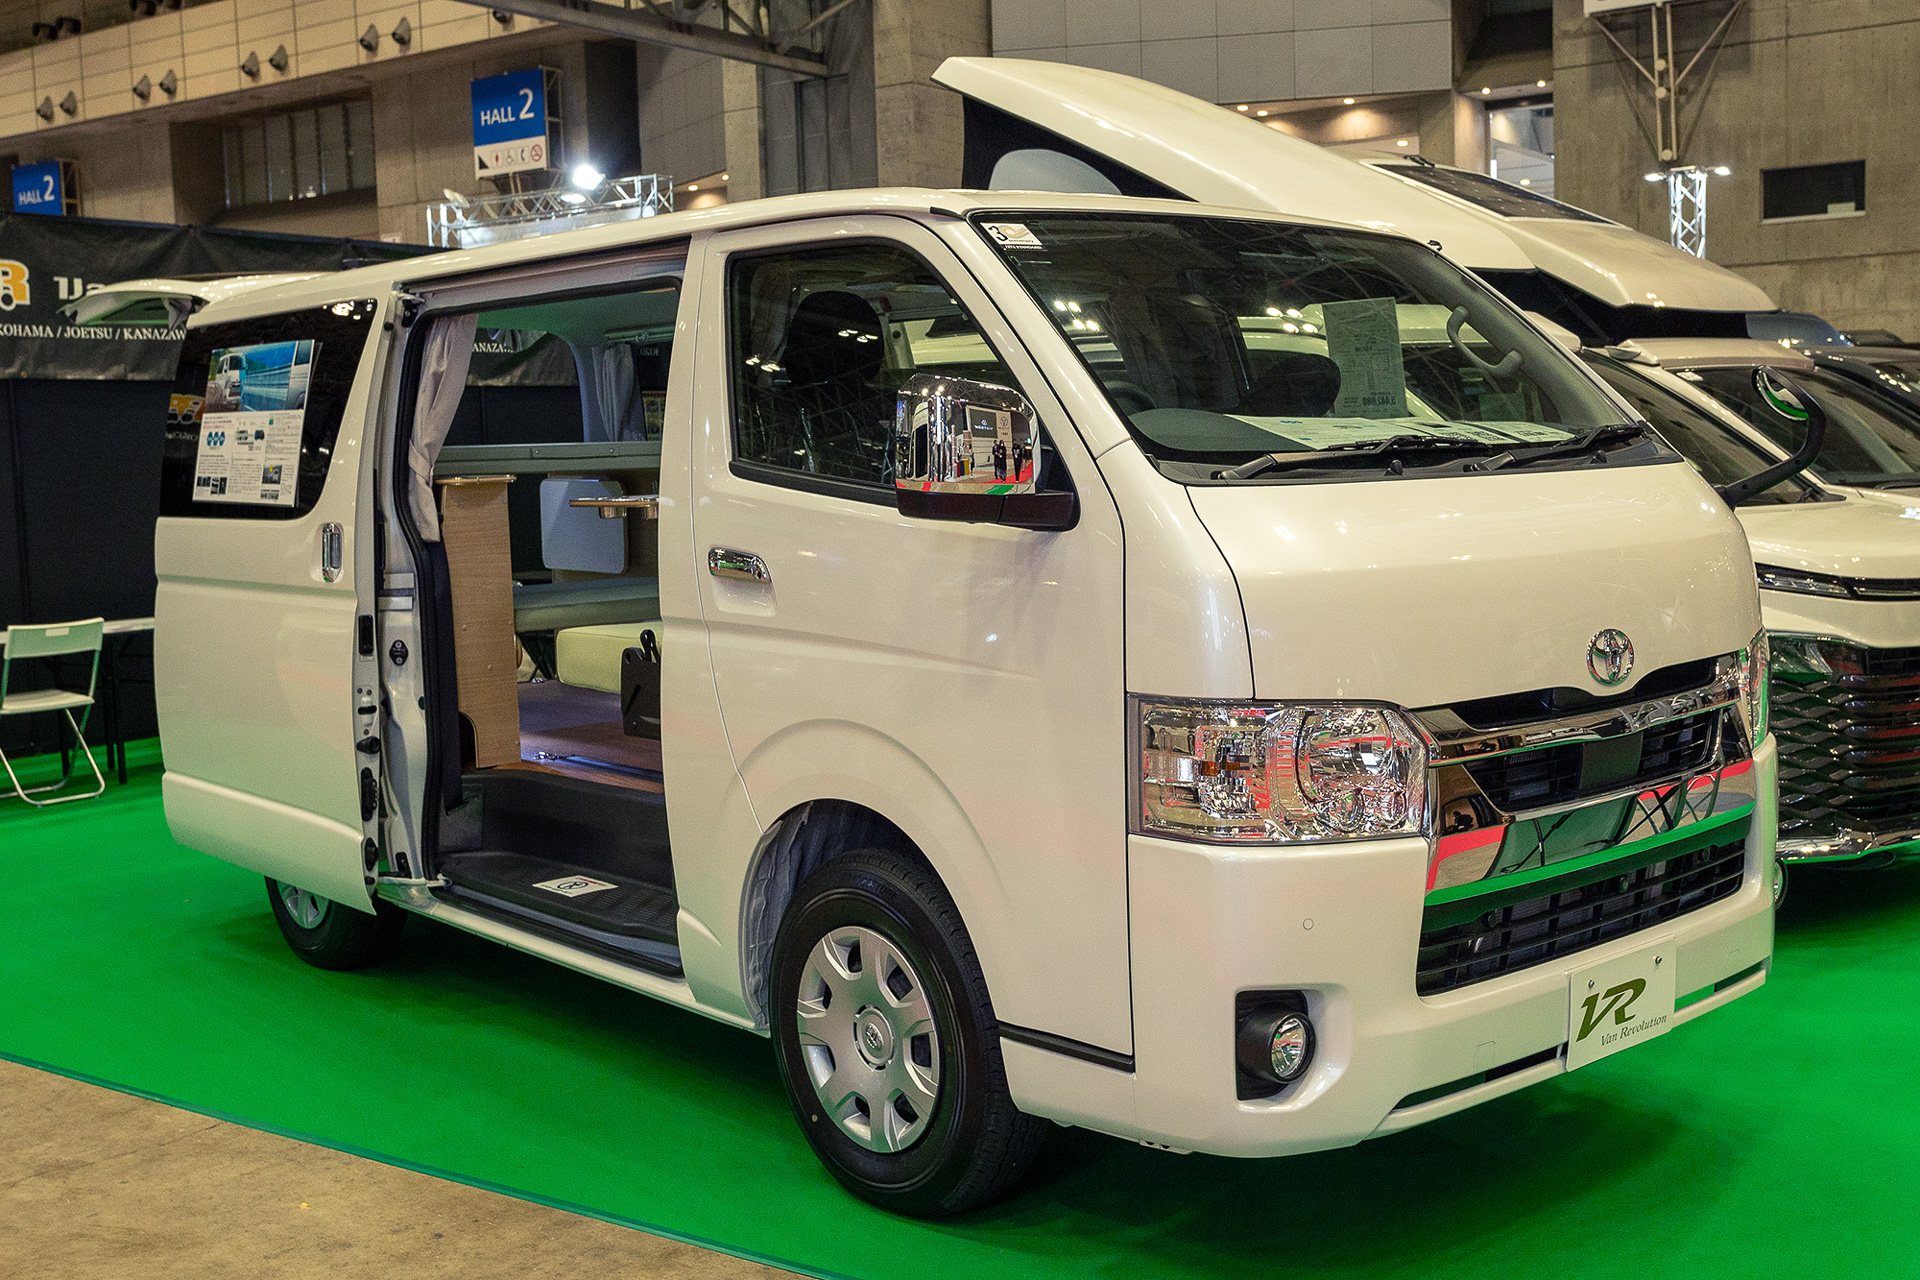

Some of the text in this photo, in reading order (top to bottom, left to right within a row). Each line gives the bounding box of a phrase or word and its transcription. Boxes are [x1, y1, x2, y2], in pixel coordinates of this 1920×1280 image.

[481, 88, 535, 126] HALL 2
[18, 175, 55, 206] HALL 2
[63, 327, 113, 340] JOETSU
[1601, 1015, 1667, 1046] Van Revolution
